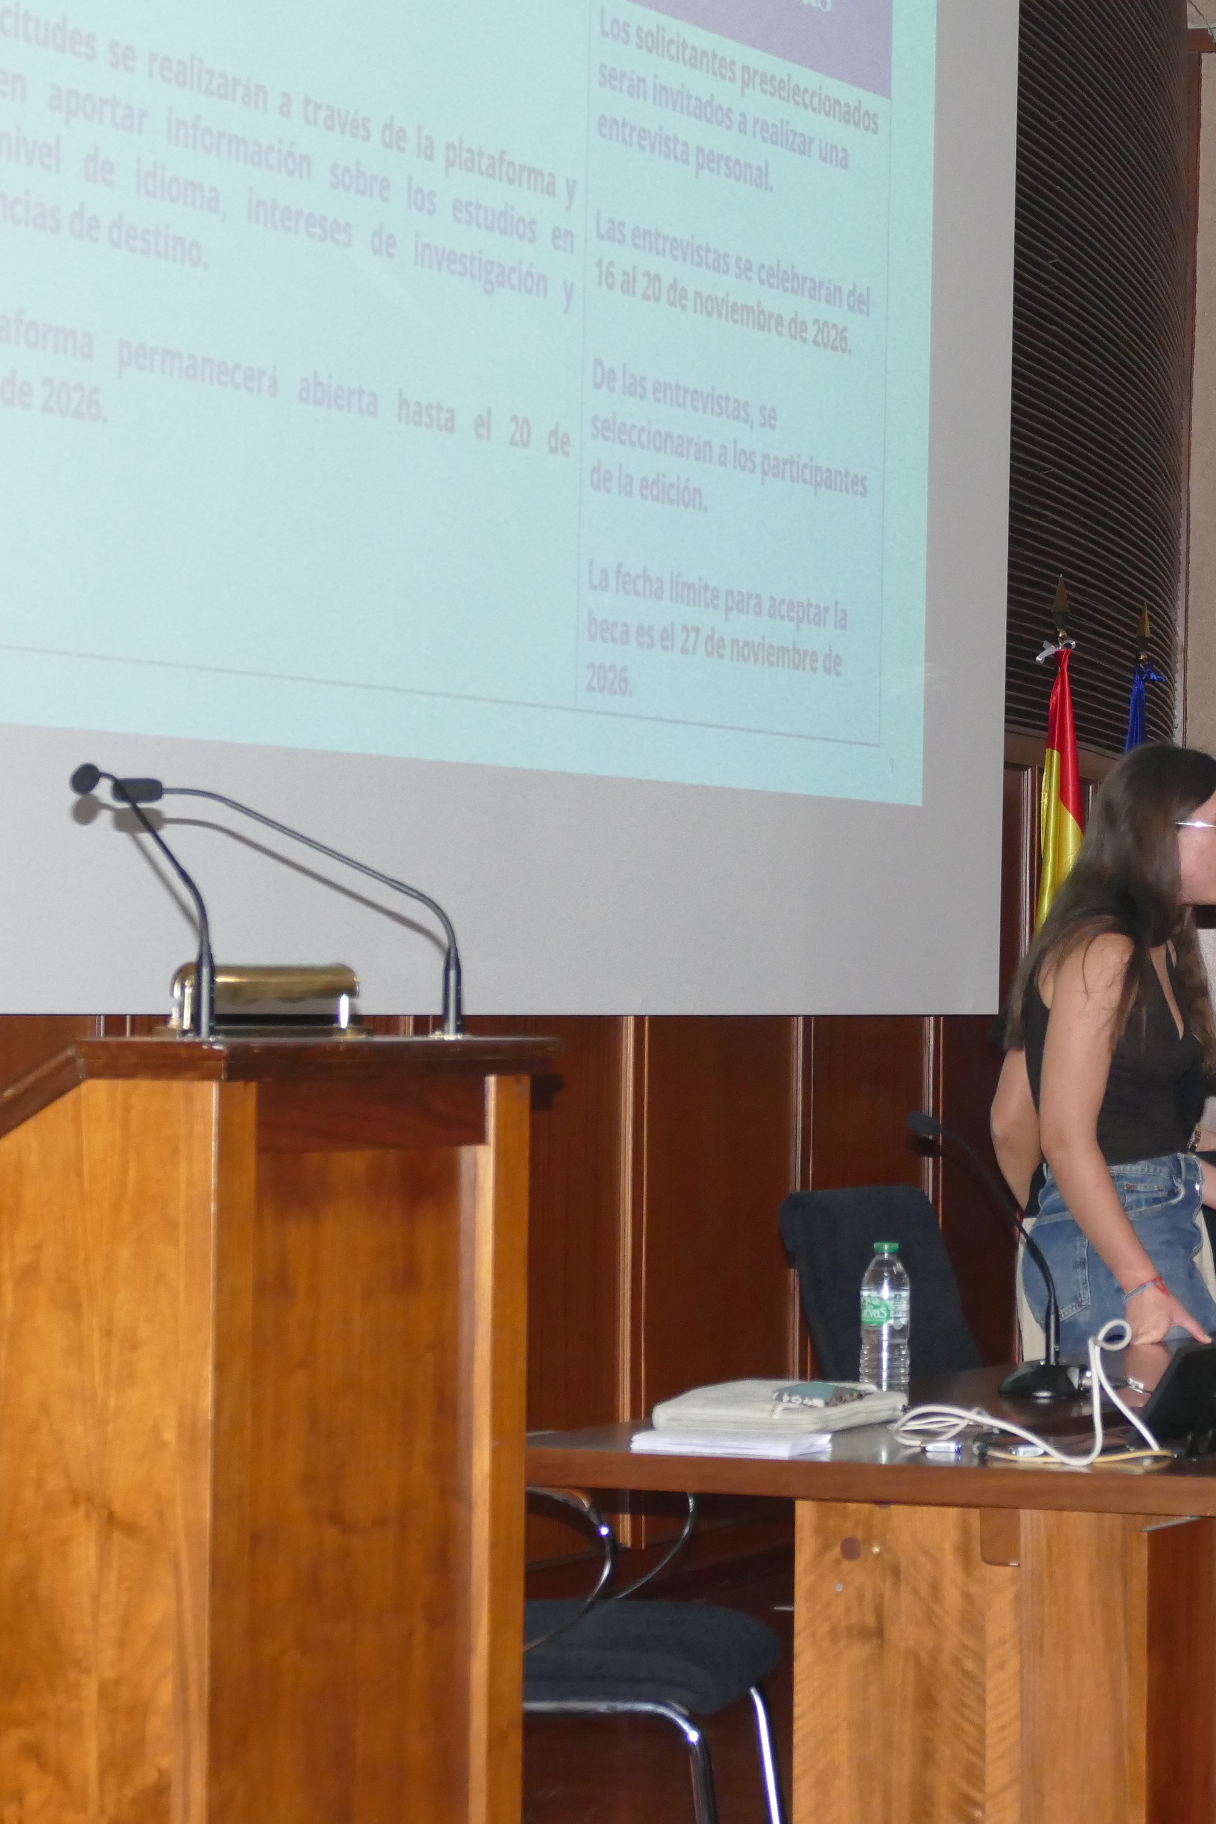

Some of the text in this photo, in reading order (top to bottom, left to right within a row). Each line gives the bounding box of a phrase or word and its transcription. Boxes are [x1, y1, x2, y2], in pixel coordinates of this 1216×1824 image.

[601, 7, 879, 135] Los solicitantes preseleccionados
[108, 39, 136, 73] se
[148, 51, 268, 113] realizarán
[278, 91, 292, 120] a
[303, 94, 371, 142] través
[381, 115, 407, 153] de
[416, 124, 435, 161] la
[445, 135, 557, 198] plataforma
[565, 176, 577, 212] y
[597, 113, 774, 193] entrevista personal.
[598, 61, 849, 170] serán invitados a realizar una
[48, 82, 148, 136] aportar
[167, 106, 312, 181] información
[329, 159, 391, 203] sobre
[407, 175, 436, 216] los
[452, 197, 537, 244] estudios
[552, 225, 574, 254] en
[69, 202, 101, 244] de
[108, 211, 208, 270] destino.
[82, 145, 115, 188] de
[135, 156, 227, 223] idioma,
[248, 186, 353, 248] intereses
[370, 221, 397, 260] de
[414, 230, 548, 299] investigación
[563, 279, 574, 314] y
[595, 208, 871, 316] Las entrevistas se celebrarán del
[595, 258, 852, 355] 16 al 20 de noviembre de 2026.
[1, 368, 108, 424] de 2026.
[117, 338, 279, 398] permanecerá
[298, 370, 378, 418] abierta
[397, 388, 456, 434] hasta
[474, 407, 492, 441] el
[508, 414, 531, 448] 20
[547, 421, 571, 457] de
[593, 358, 777, 431] De las entrevistas, se
[590, 458, 708, 513] de la edición.
[591, 411, 867, 498] seleccionarán a los participantes
[588, 560, 848, 632] La fecha límite para aceptar la
[586, 662, 633, 697] 2026.
[587, 608, 843, 677] beca es el 27 de noviembre de
